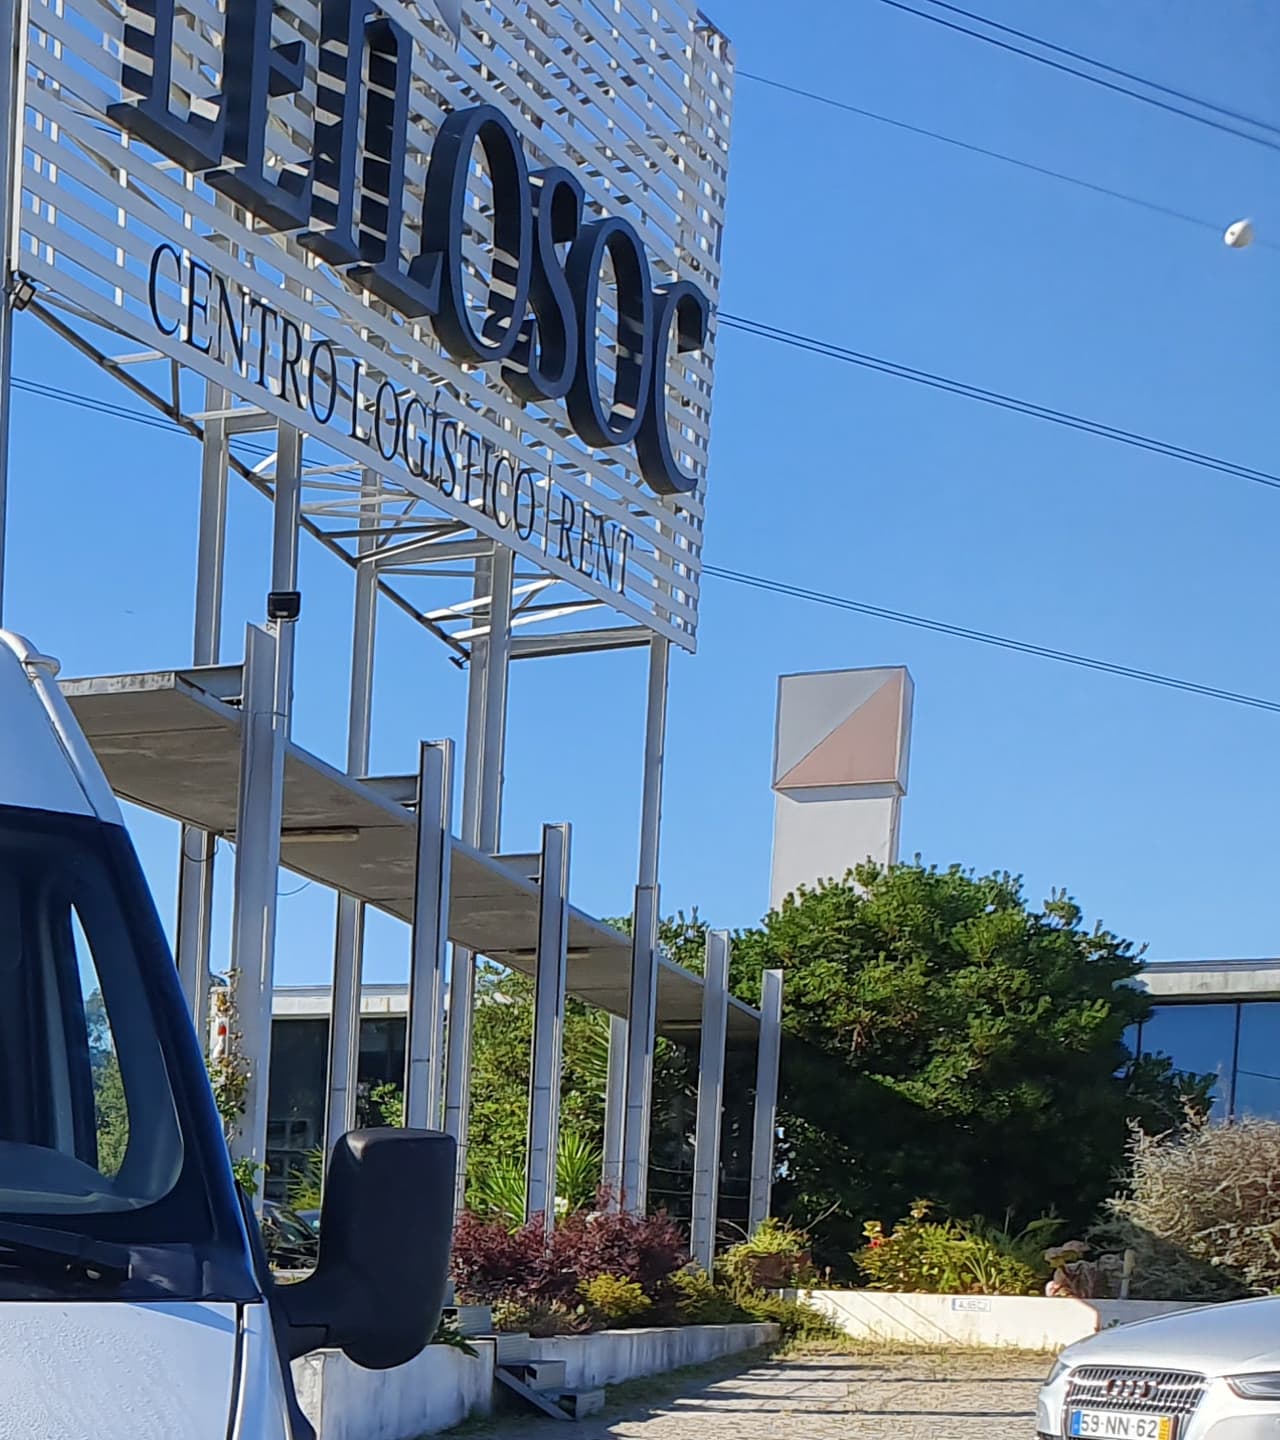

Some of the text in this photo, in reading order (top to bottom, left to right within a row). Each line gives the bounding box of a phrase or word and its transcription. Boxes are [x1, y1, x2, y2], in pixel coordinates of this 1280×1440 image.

[148, 243, 337, 425] CENTRO
[348, 359, 535, 541] LOGÍSTICO
[557, 491, 635, 597] RENT
